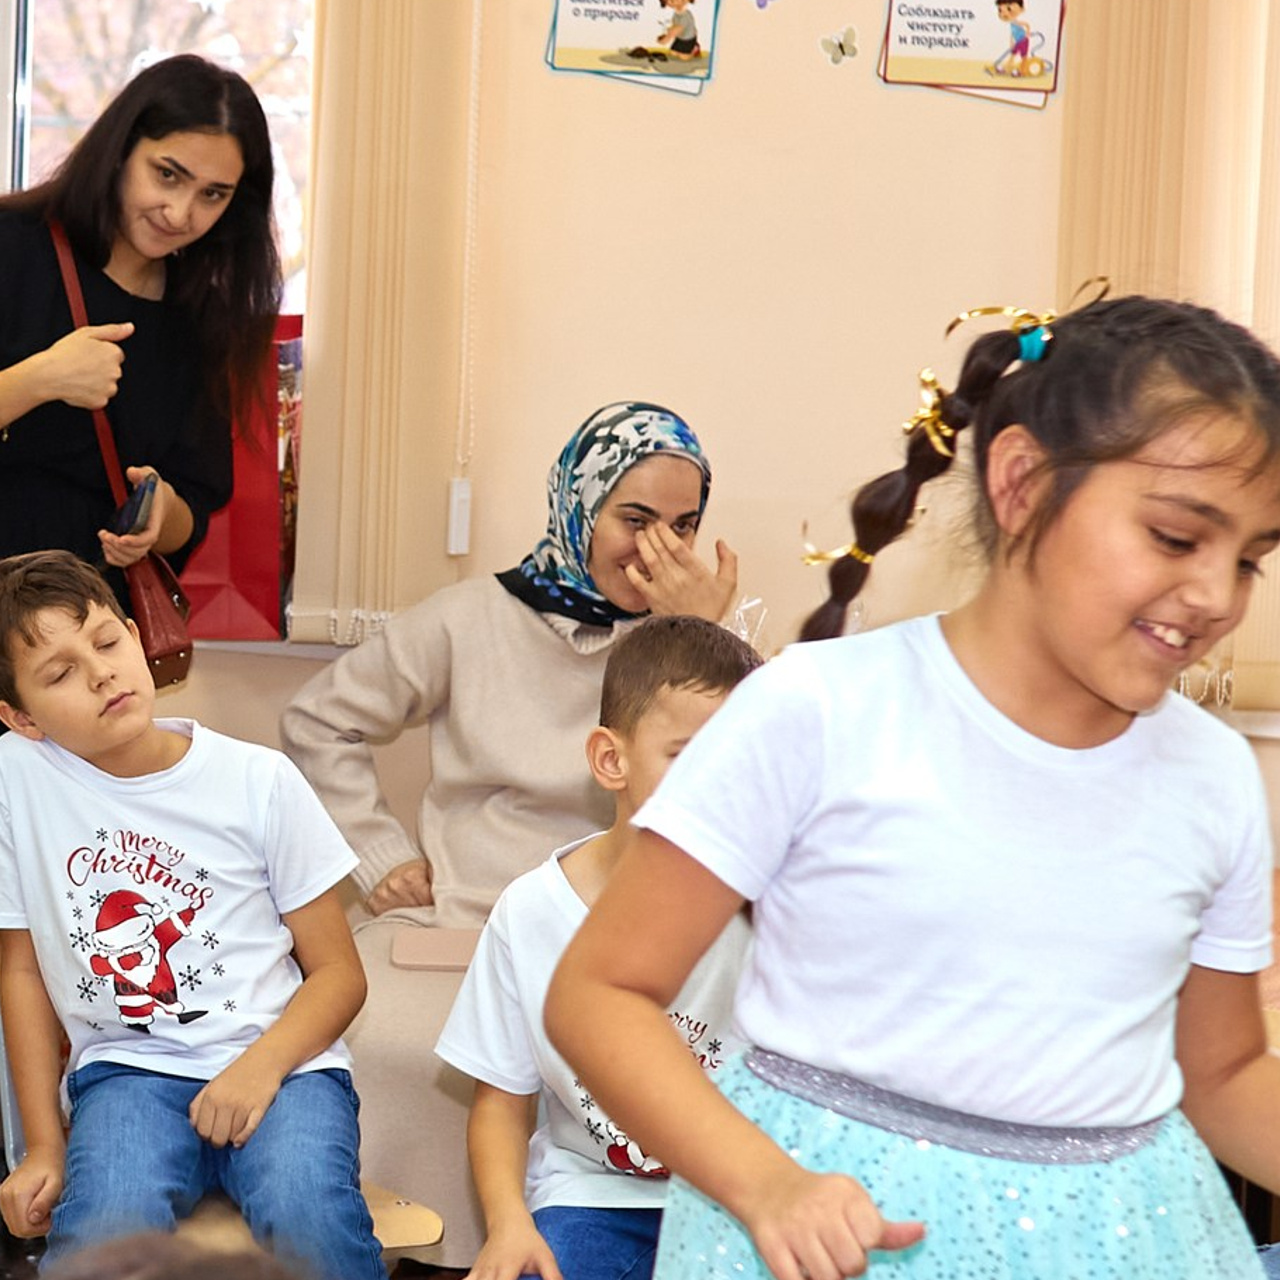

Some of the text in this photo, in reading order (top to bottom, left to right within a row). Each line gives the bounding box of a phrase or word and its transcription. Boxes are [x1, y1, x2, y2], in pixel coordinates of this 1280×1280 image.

[573, 7, 640, 22] о природе
[898, 3, 975, 20] Соблюдать
[906, 21, 963, 36] чистоту
[898, 35, 970, 49] и порядок
[113, 829, 186, 867] Merry
[67, 847, 214, 911] Christmas
[670, 1011, 709, 1044] rry
